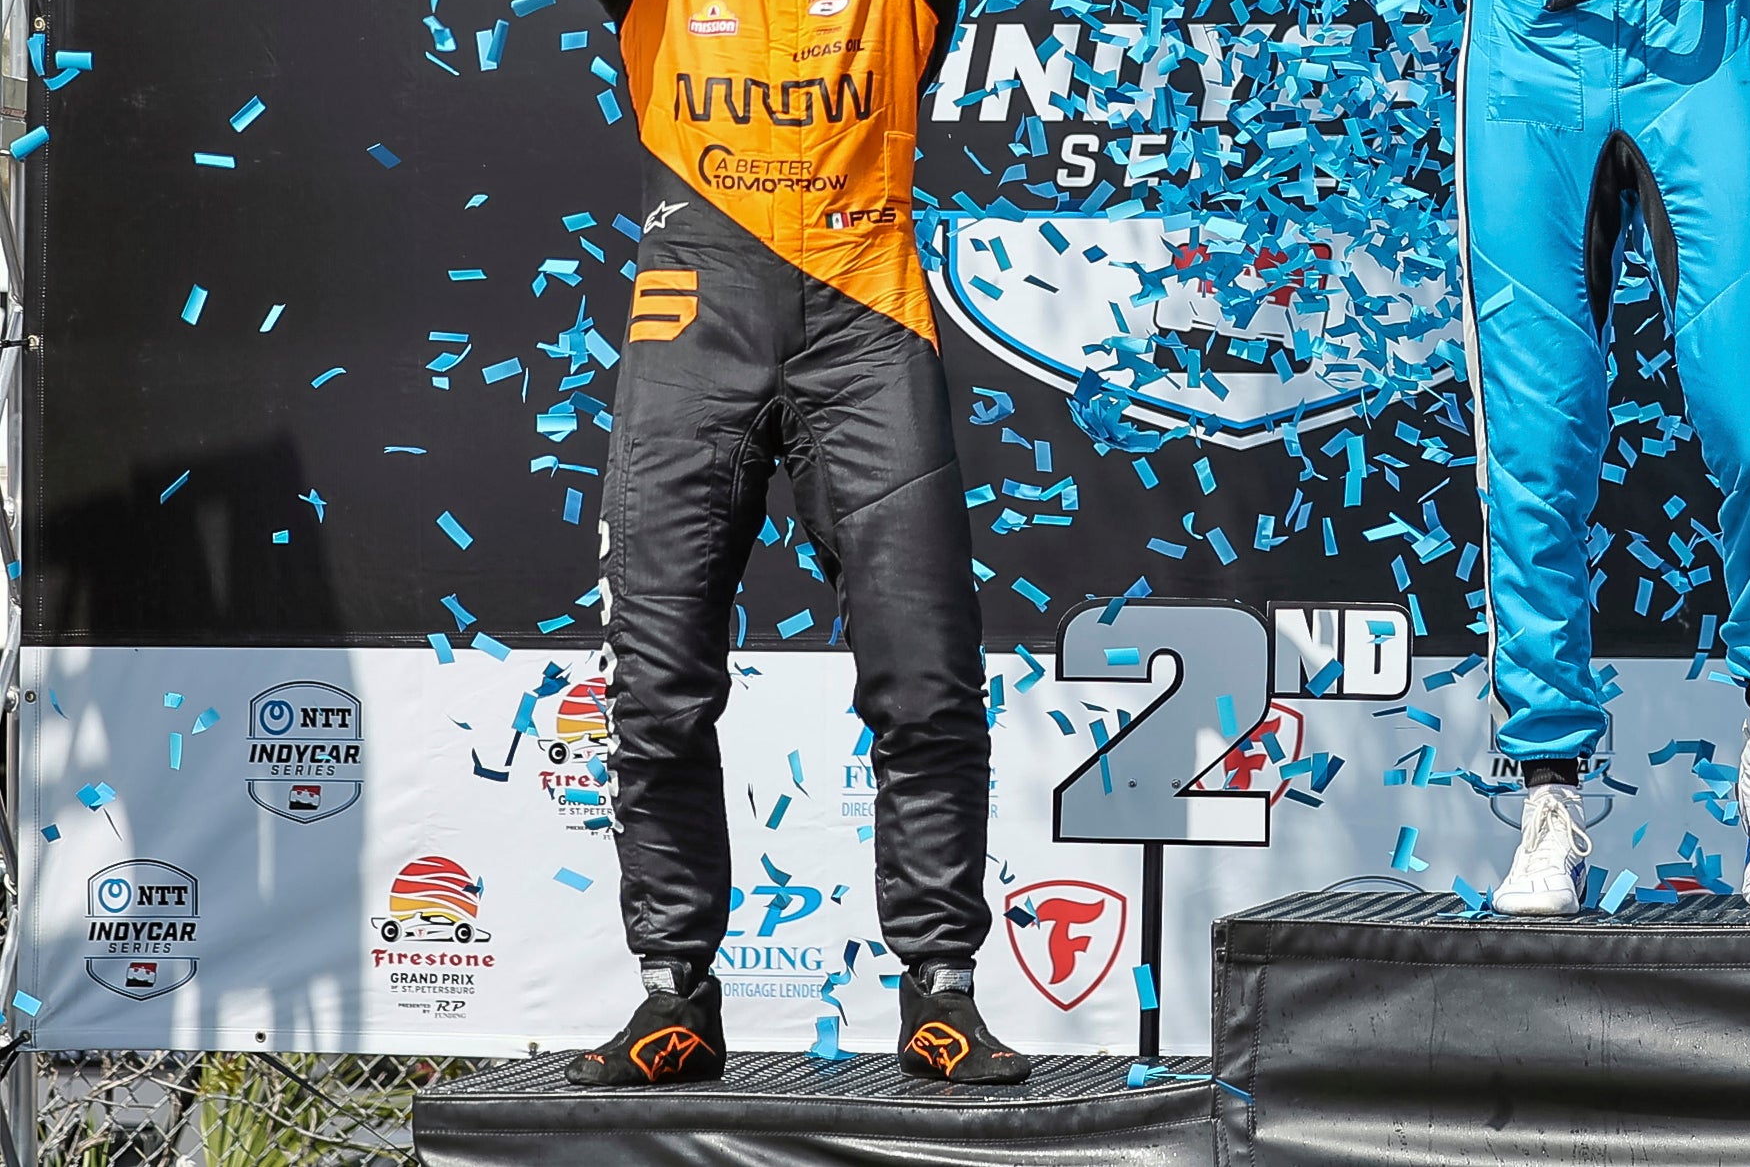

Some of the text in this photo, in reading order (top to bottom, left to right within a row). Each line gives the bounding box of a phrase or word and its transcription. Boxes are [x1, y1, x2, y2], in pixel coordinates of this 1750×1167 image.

[690, 20, 737, 34] mission
[793, 38, 866, 63] LUCAS OIL
[735, 159, 813, 176] BETTER
[300, 707, 352, 728] NTT
[1056, 604, 1411, 844] 2ND
[249, 743, 361, 764] INDYCAR
[270, 764, 336, 776] SERIES
[841, 802, 875, 817] DIREC
[137, 885, 189, 906] NTT
[88, 921, 197, 942] INDYCAR
[108, 942, 172, 953] SERIES
[371, 949, 496, 968] Firestone
[715, 946, 824, 971] NDING
[390, 972, 475, 986] GRAND PRIX
[723, 982, 778, 998] ORTGAGE
[435, 1000, 466, 1012] RP
